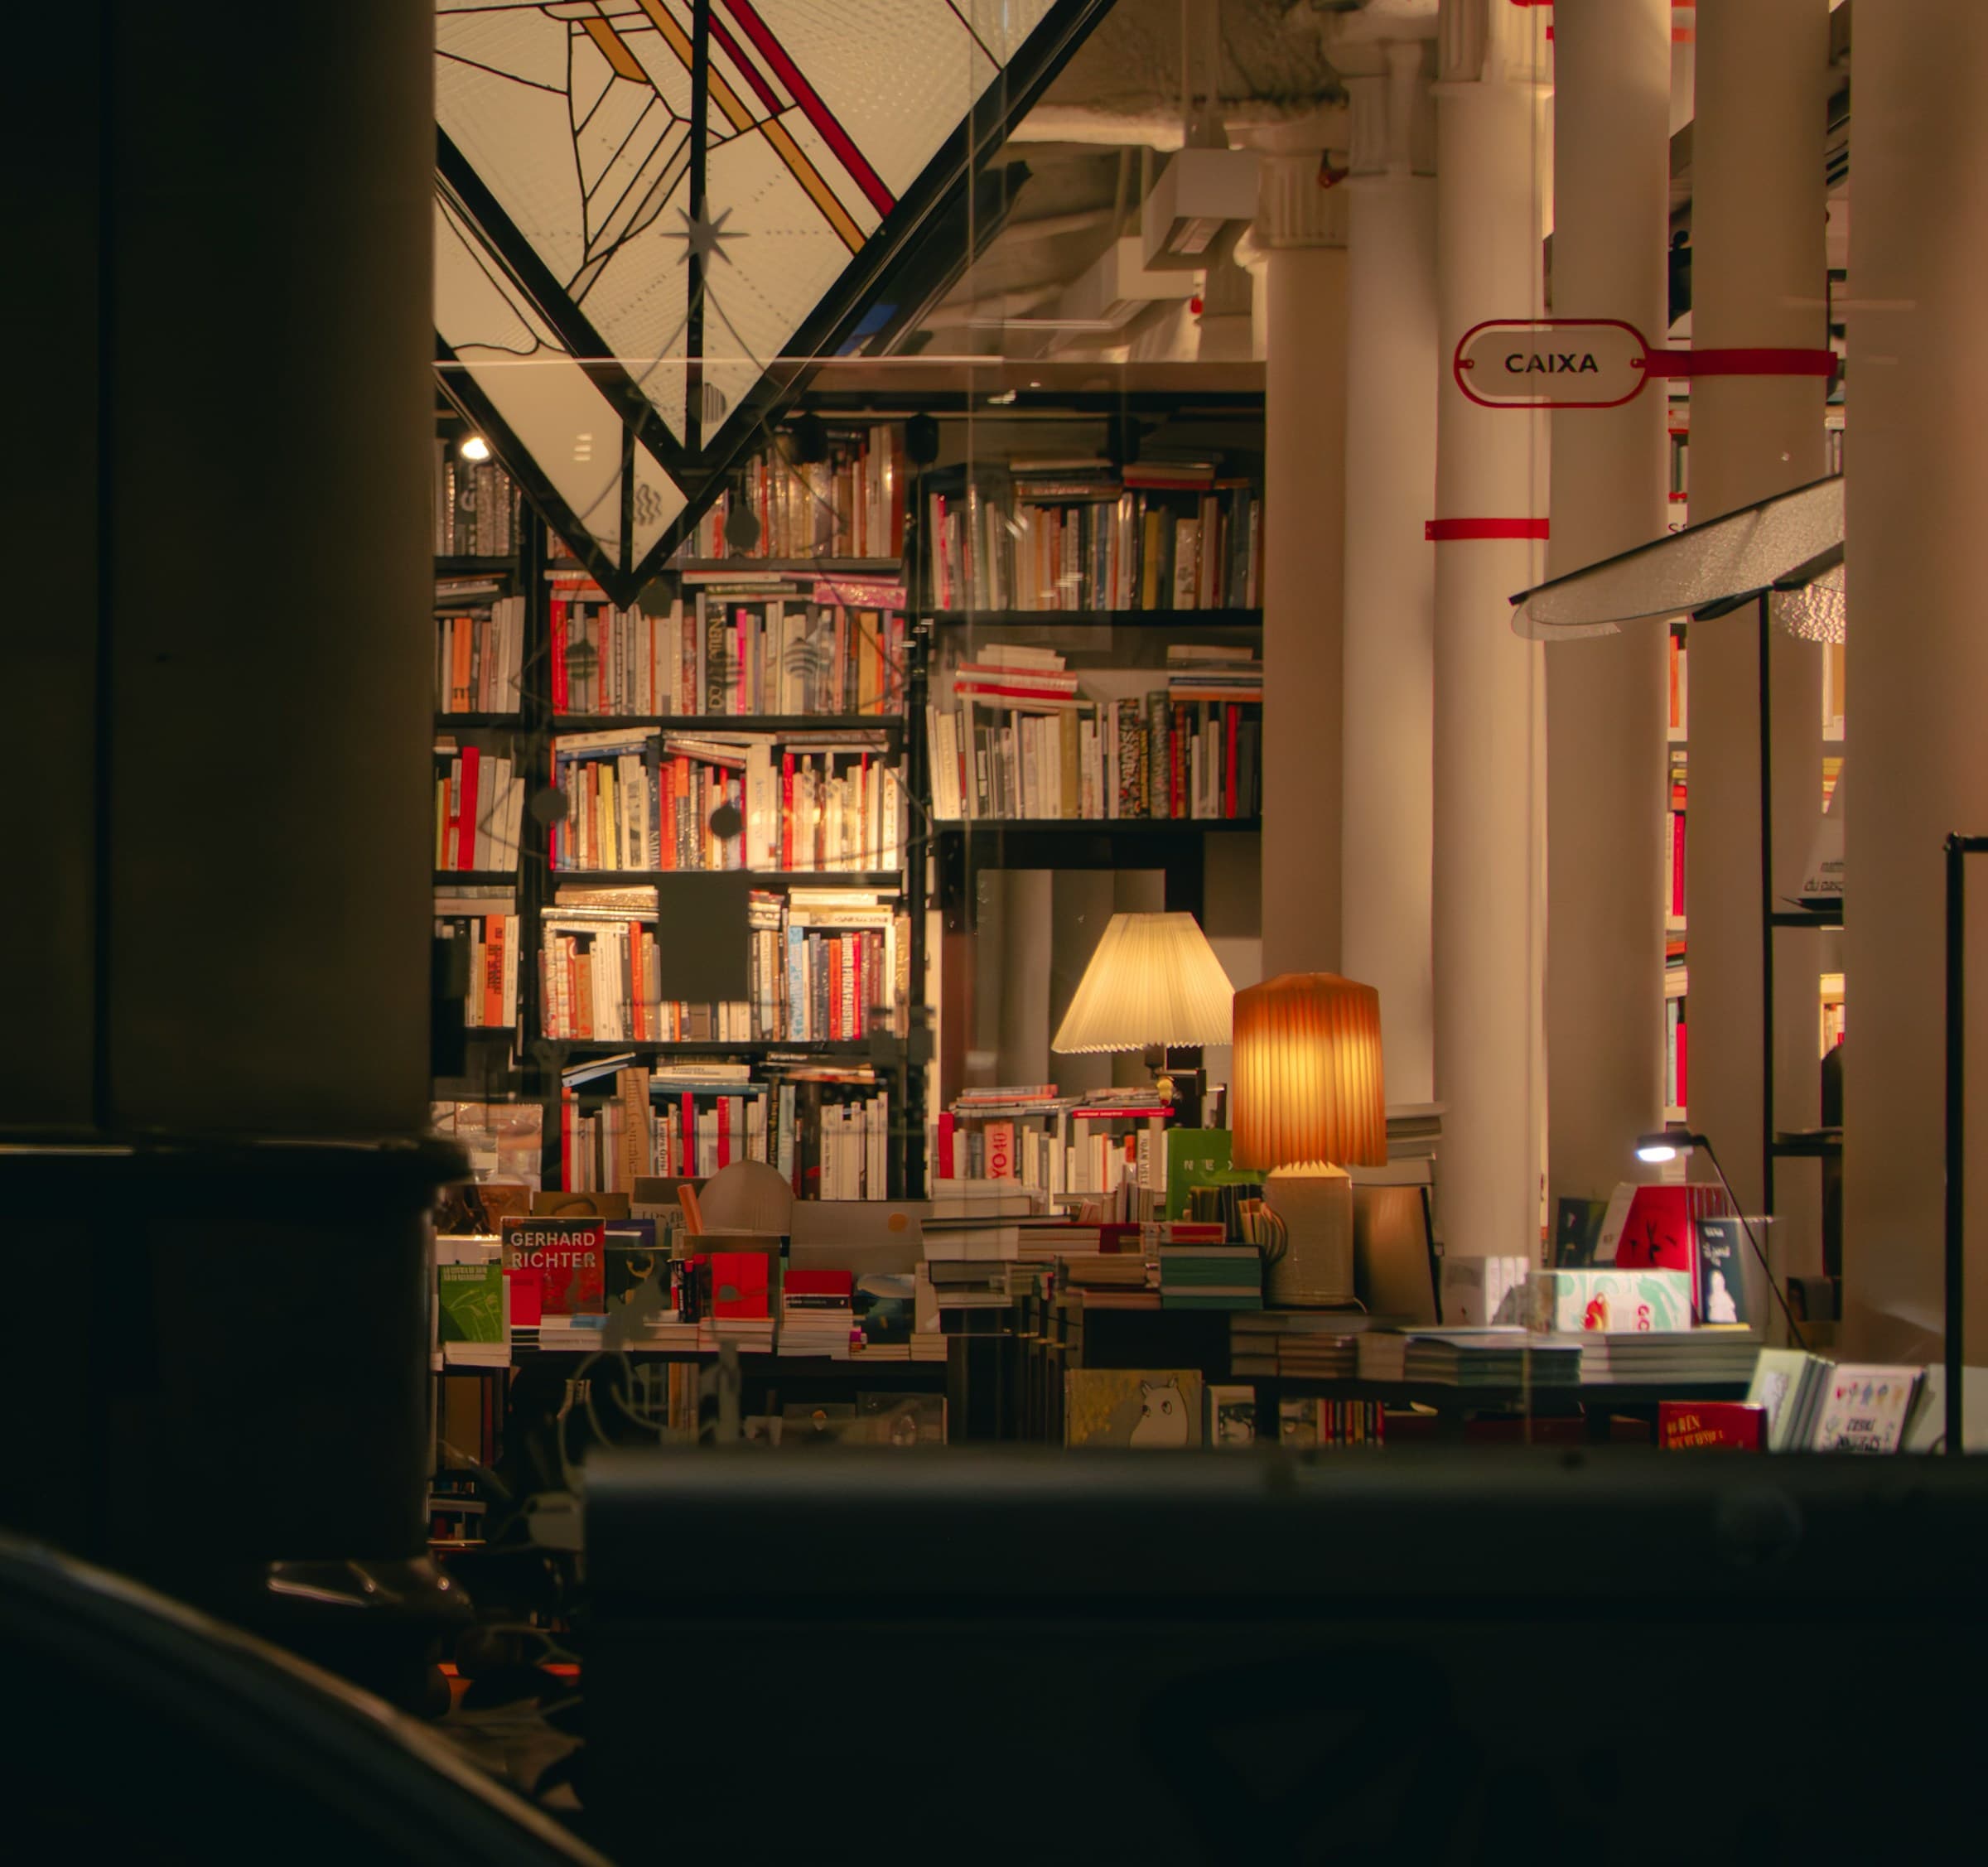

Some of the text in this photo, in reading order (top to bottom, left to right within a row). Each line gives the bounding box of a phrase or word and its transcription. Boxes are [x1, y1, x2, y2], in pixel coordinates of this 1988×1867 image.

[1504, 352, 1599, 373] CAIXA
[509, 1231, 596, 1248] GERHARD
[511, 1252, 596, 1269] RICHTER
